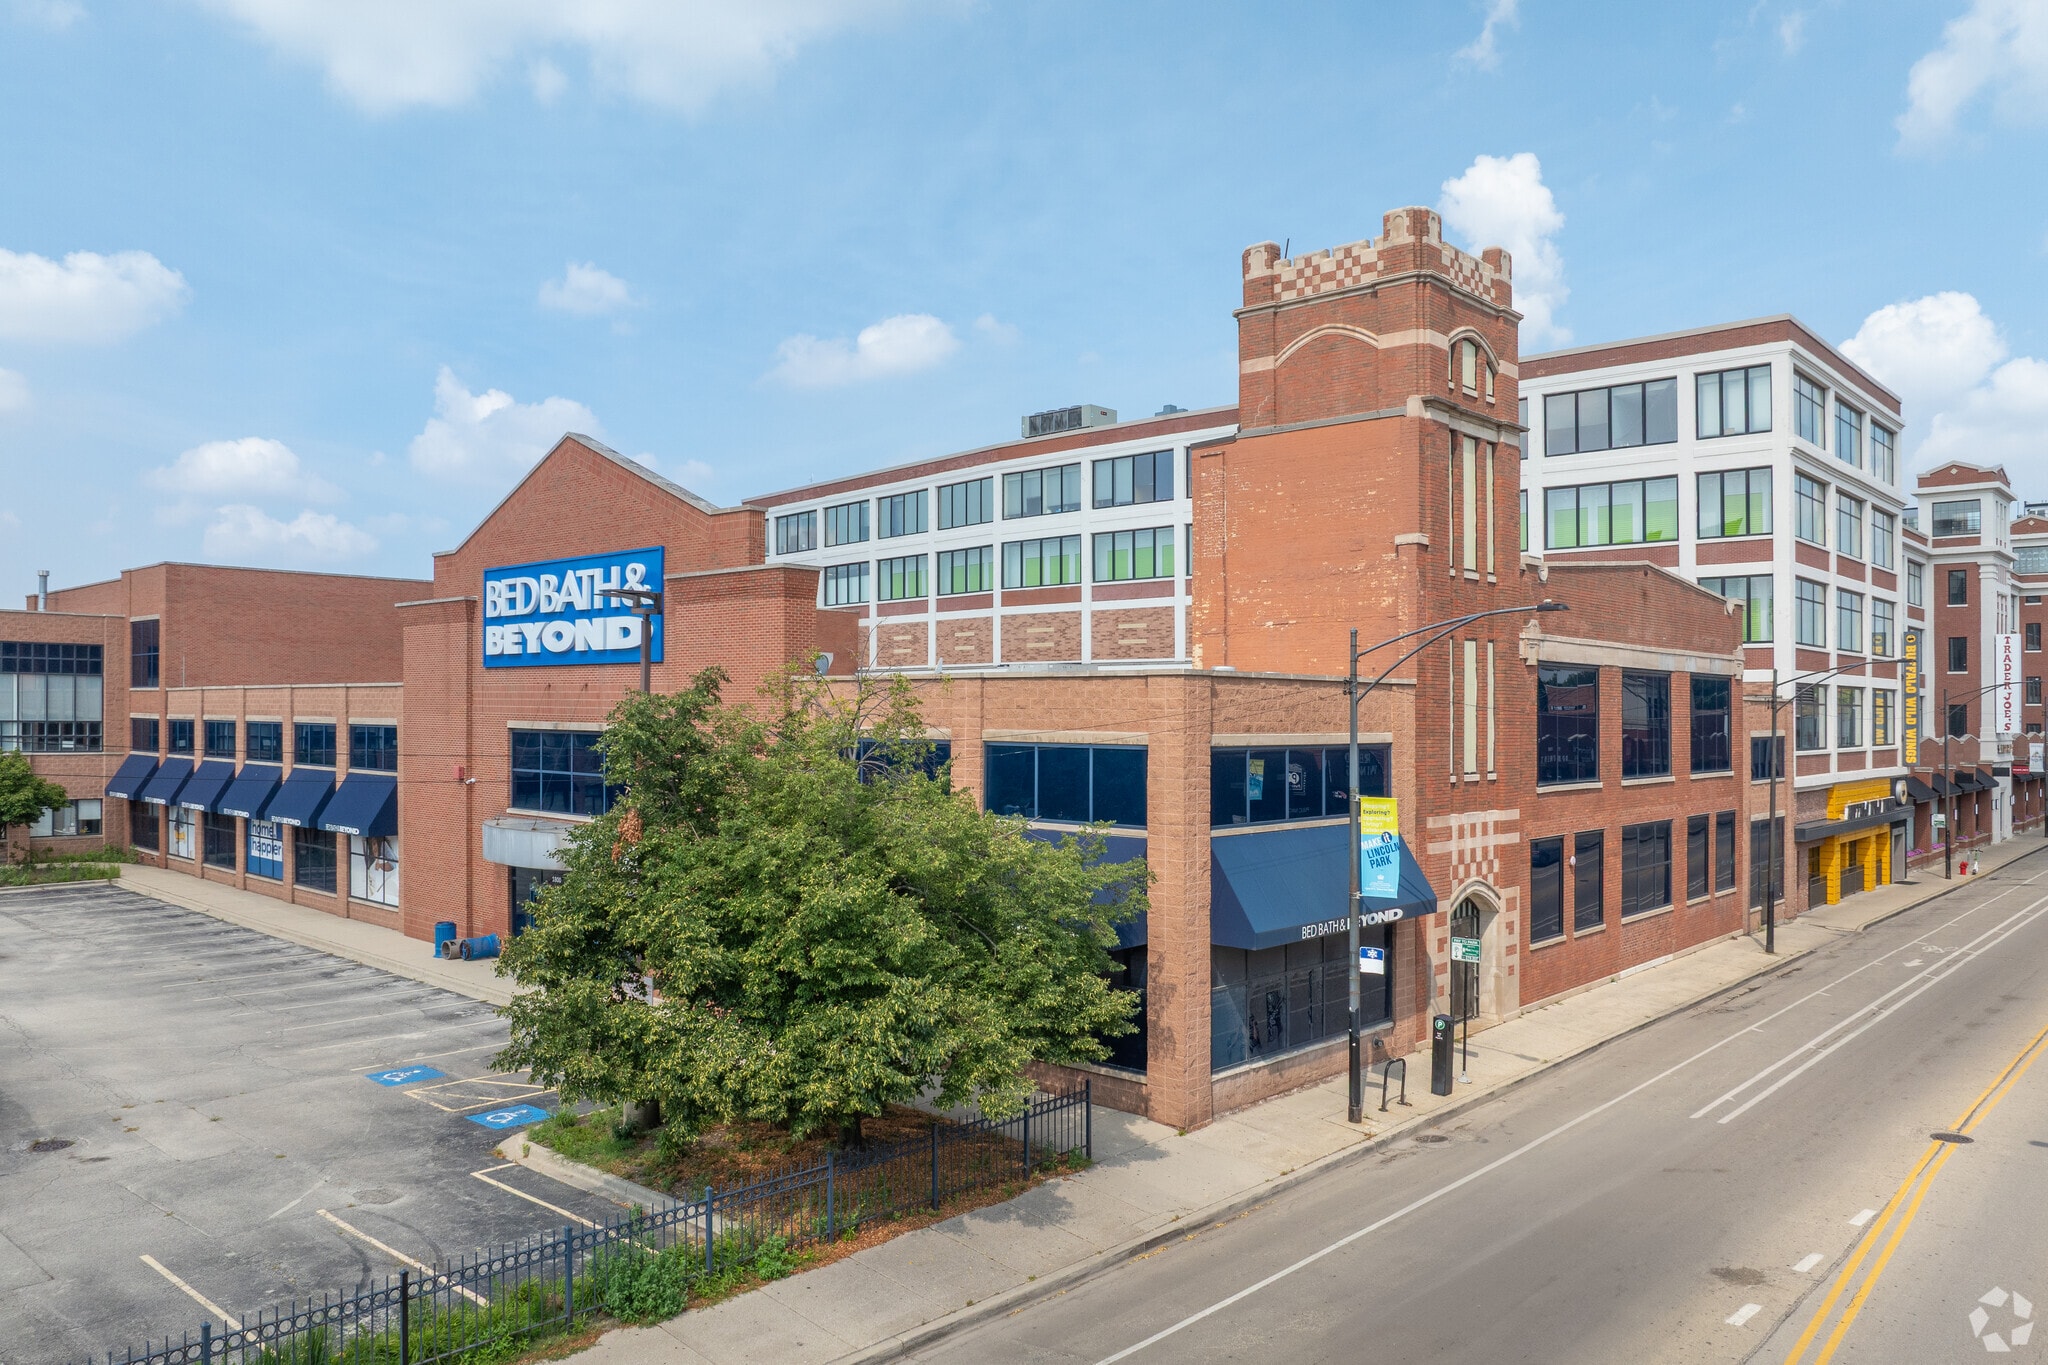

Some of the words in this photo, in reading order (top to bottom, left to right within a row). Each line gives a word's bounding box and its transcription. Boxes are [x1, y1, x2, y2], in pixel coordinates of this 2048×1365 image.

[486, 576, 540, 618] BED
[540, 566, 621, 614] BATH
[622, 563, 654, 607] &
[486, 616, 653, 655] BEYOND
[2003, 636, 2012, 689] TRADER
[1906, 697, 1917, 725] WILD
[1906, 728, 1917, 764] WINGS
[1361, 837, 1382, 850] MAKE
[1367, 842, 1400, 859] LINCOLN
[1369, 855, 1392, 869] PARK
[1302, 922, 1317, 939] BED
[1318, 920, 1338, 936] BATH
[1340, 918, 1346, 931] &
[1347, 908, 1403, 930] YOND
